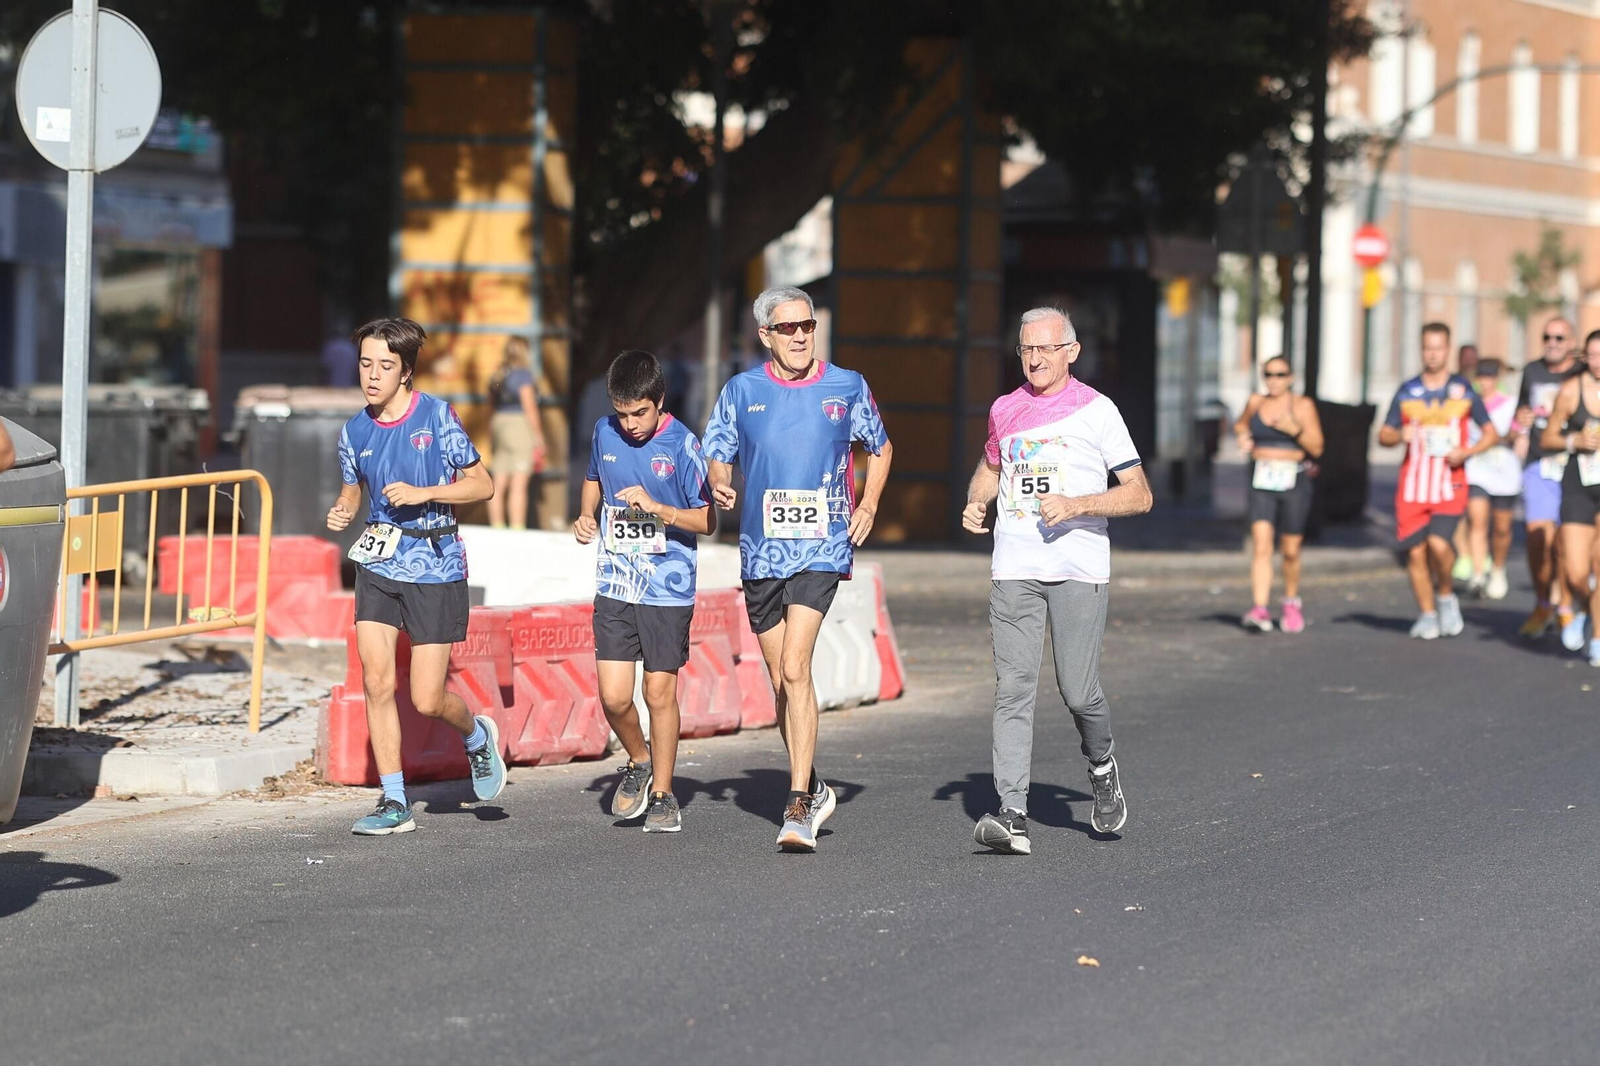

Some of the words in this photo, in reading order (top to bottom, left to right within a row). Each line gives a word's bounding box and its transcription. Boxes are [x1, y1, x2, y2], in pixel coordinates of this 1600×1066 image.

[748, 403, 766, 413] vive
[1022, 477, 1050, 494] 55
[772, 506, 818, 523] 332
[614, 522, 656, 539] 330
